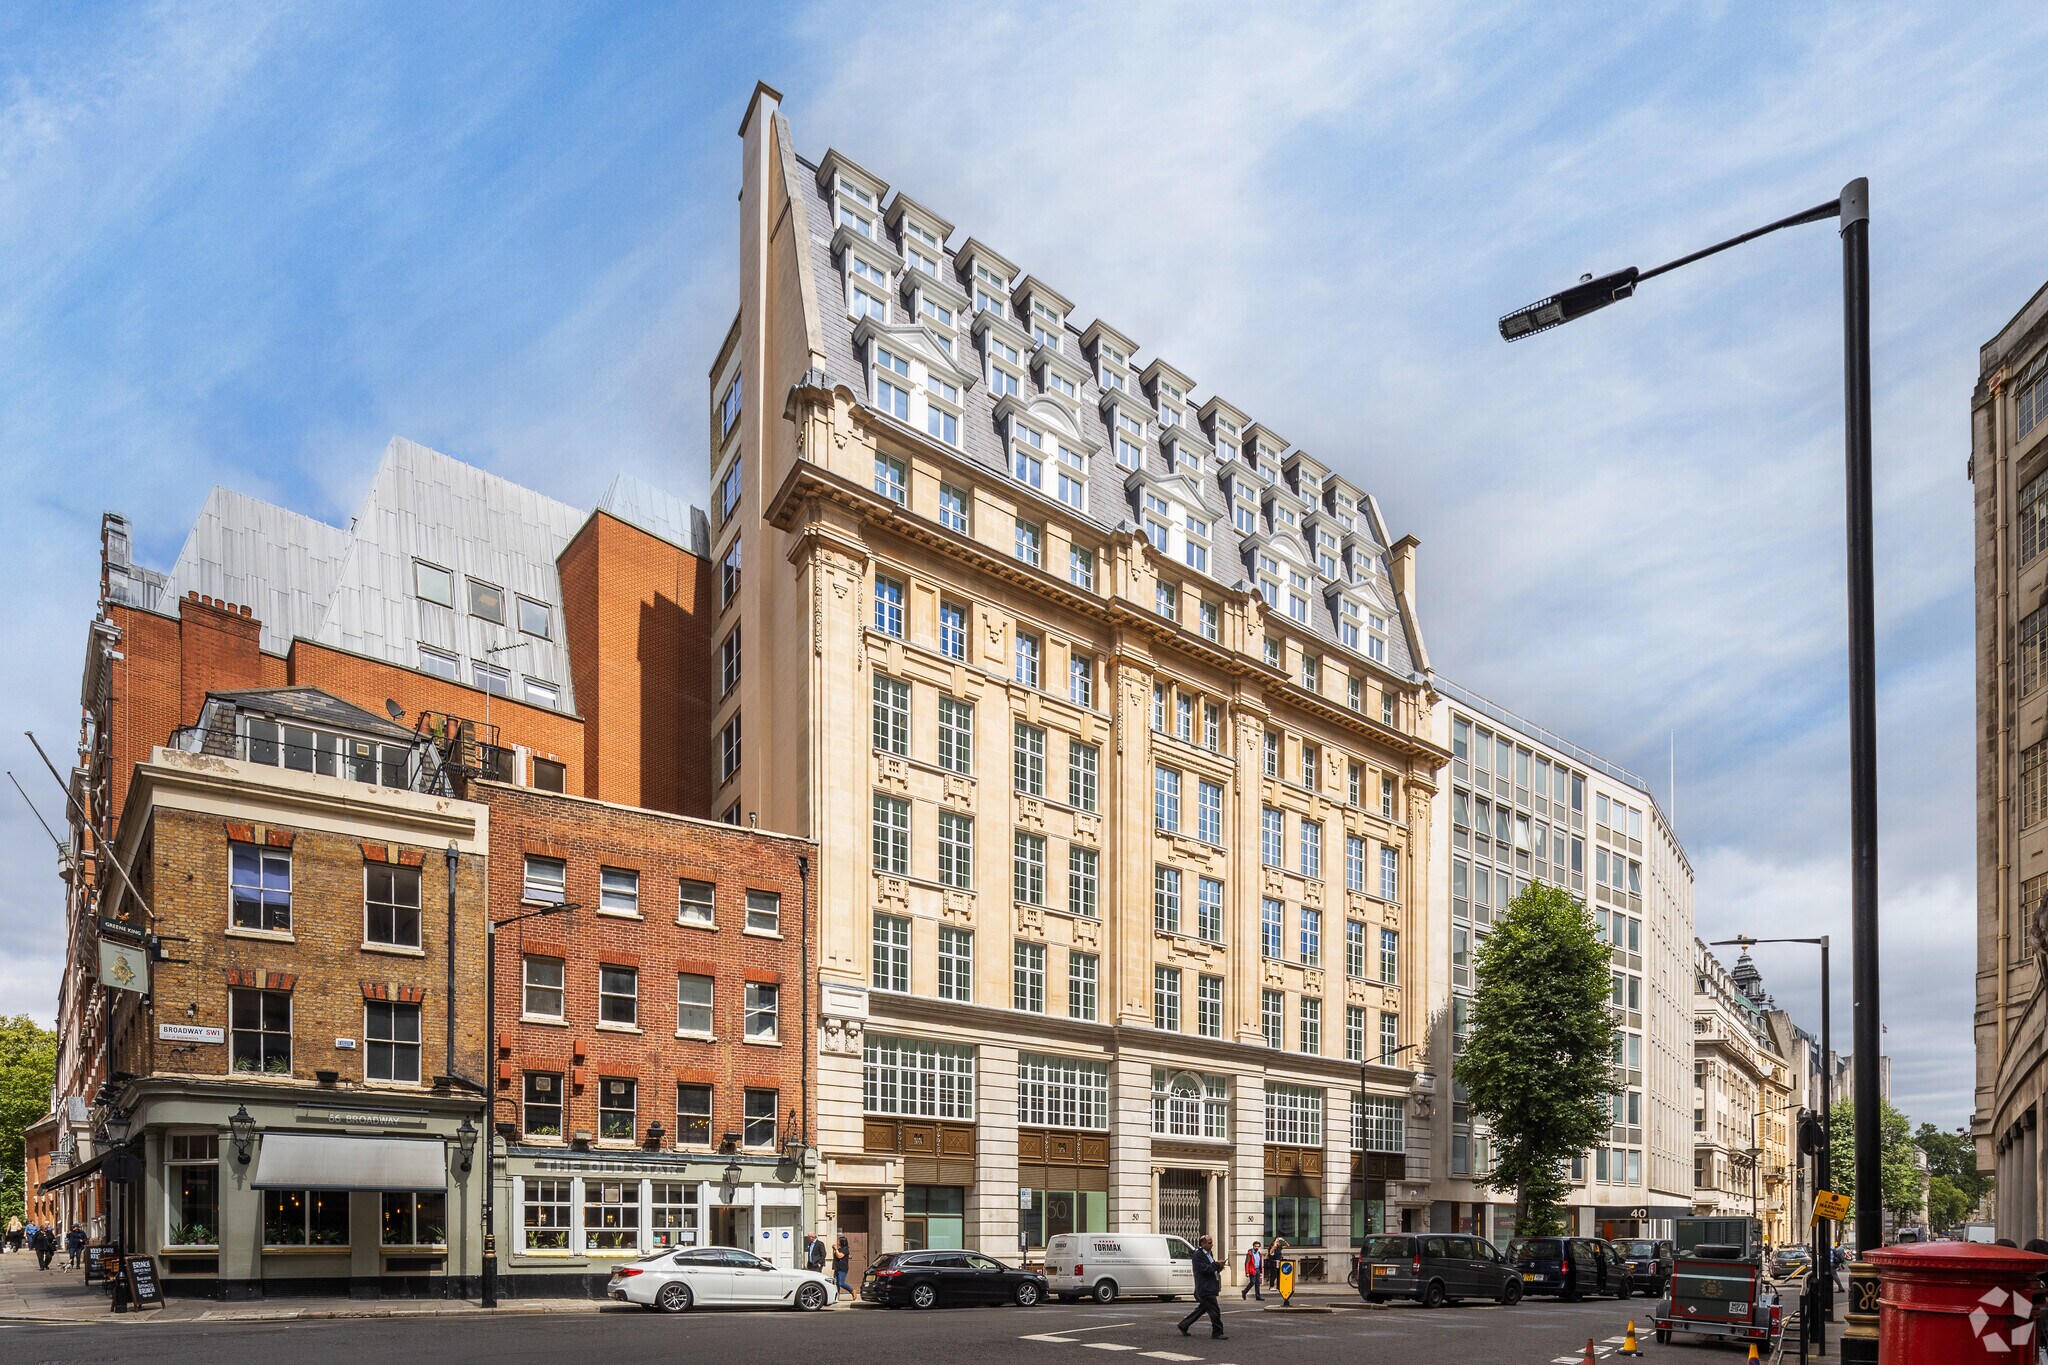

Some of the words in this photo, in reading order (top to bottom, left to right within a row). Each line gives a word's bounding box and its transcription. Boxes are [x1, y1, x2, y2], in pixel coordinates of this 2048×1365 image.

[105, 922, 126, 932] GREENE
[127, 927, 141, 936] KING
[163, 1026, 203, 1035] BROADWAY
[346, 1114, 400, 1126] BROADWAY
[542, 1158, 582, 1173] THE
[589, 1161, 625, 1174] OLD
[632, 1164, 678, 1175] STAR
[1048, 1200, 1067, 1218] 50
[1819, 1202, 1845, 1212] WARNING
[1132, 1213, 1140, 1221] 50
[1630, 1208, 1647, 1218] 40
[1093, 1243, 1122, 1252] TORMAX
